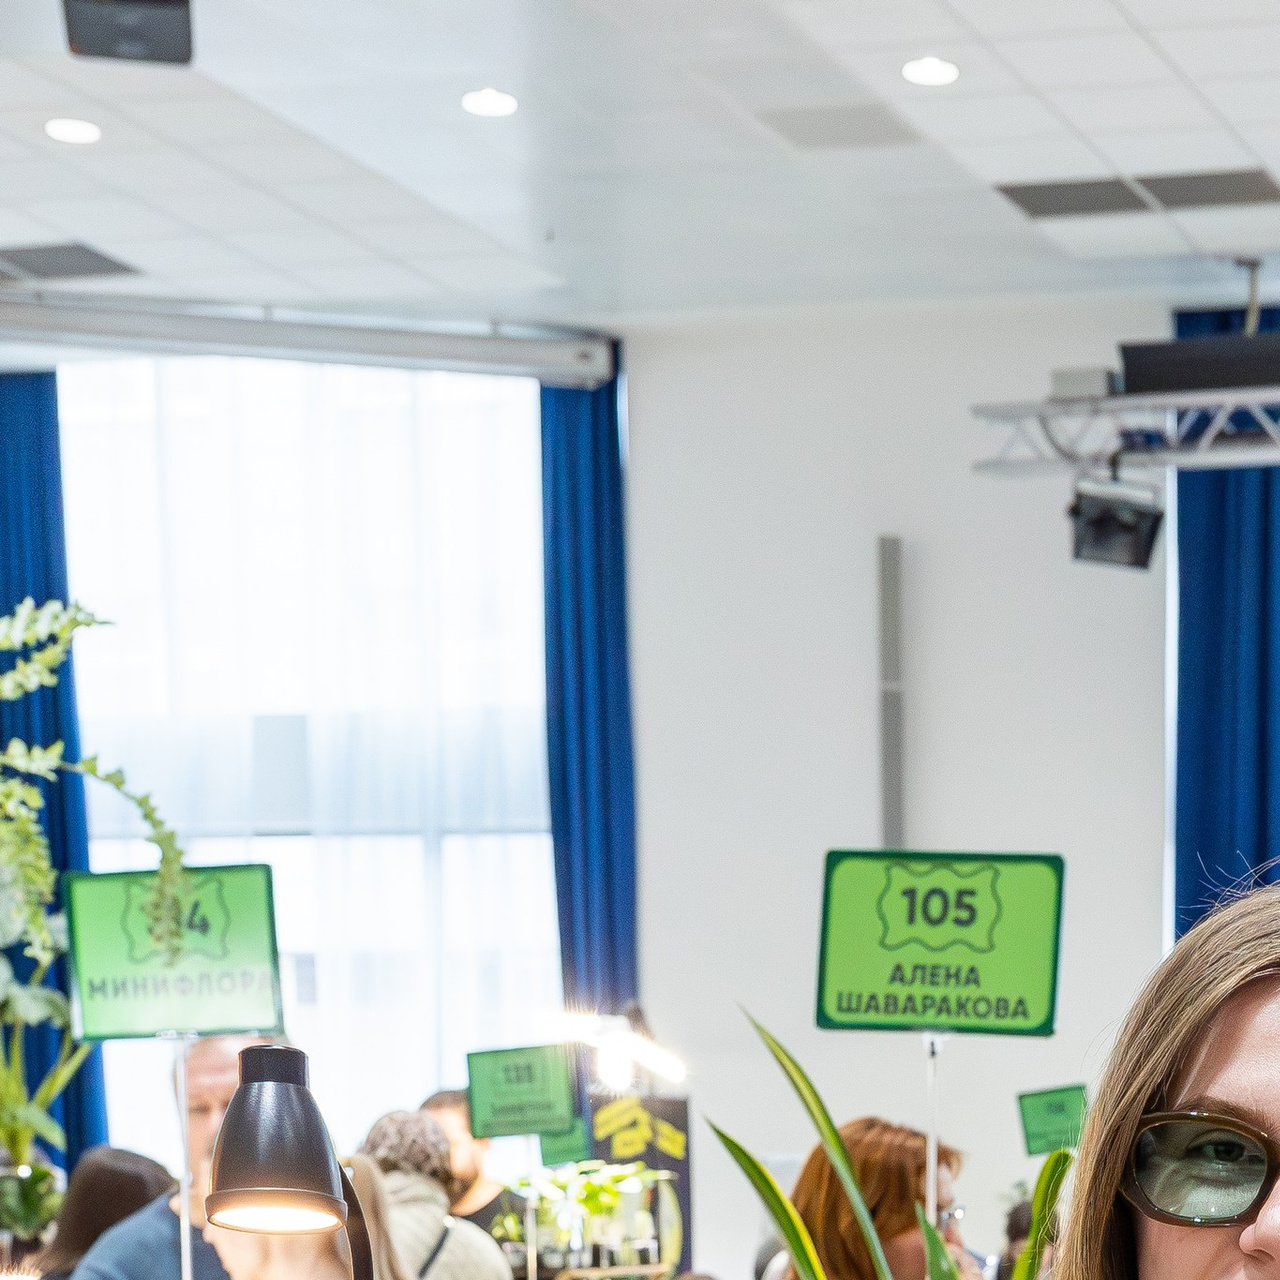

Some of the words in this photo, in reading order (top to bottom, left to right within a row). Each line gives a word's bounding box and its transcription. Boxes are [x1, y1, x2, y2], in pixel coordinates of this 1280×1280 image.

[902, 886, 978, 928] 105
[888, 962, 981, 988] АЛЕНА
[836, 990, 1030, 1021] ШАВАРАКОВА
